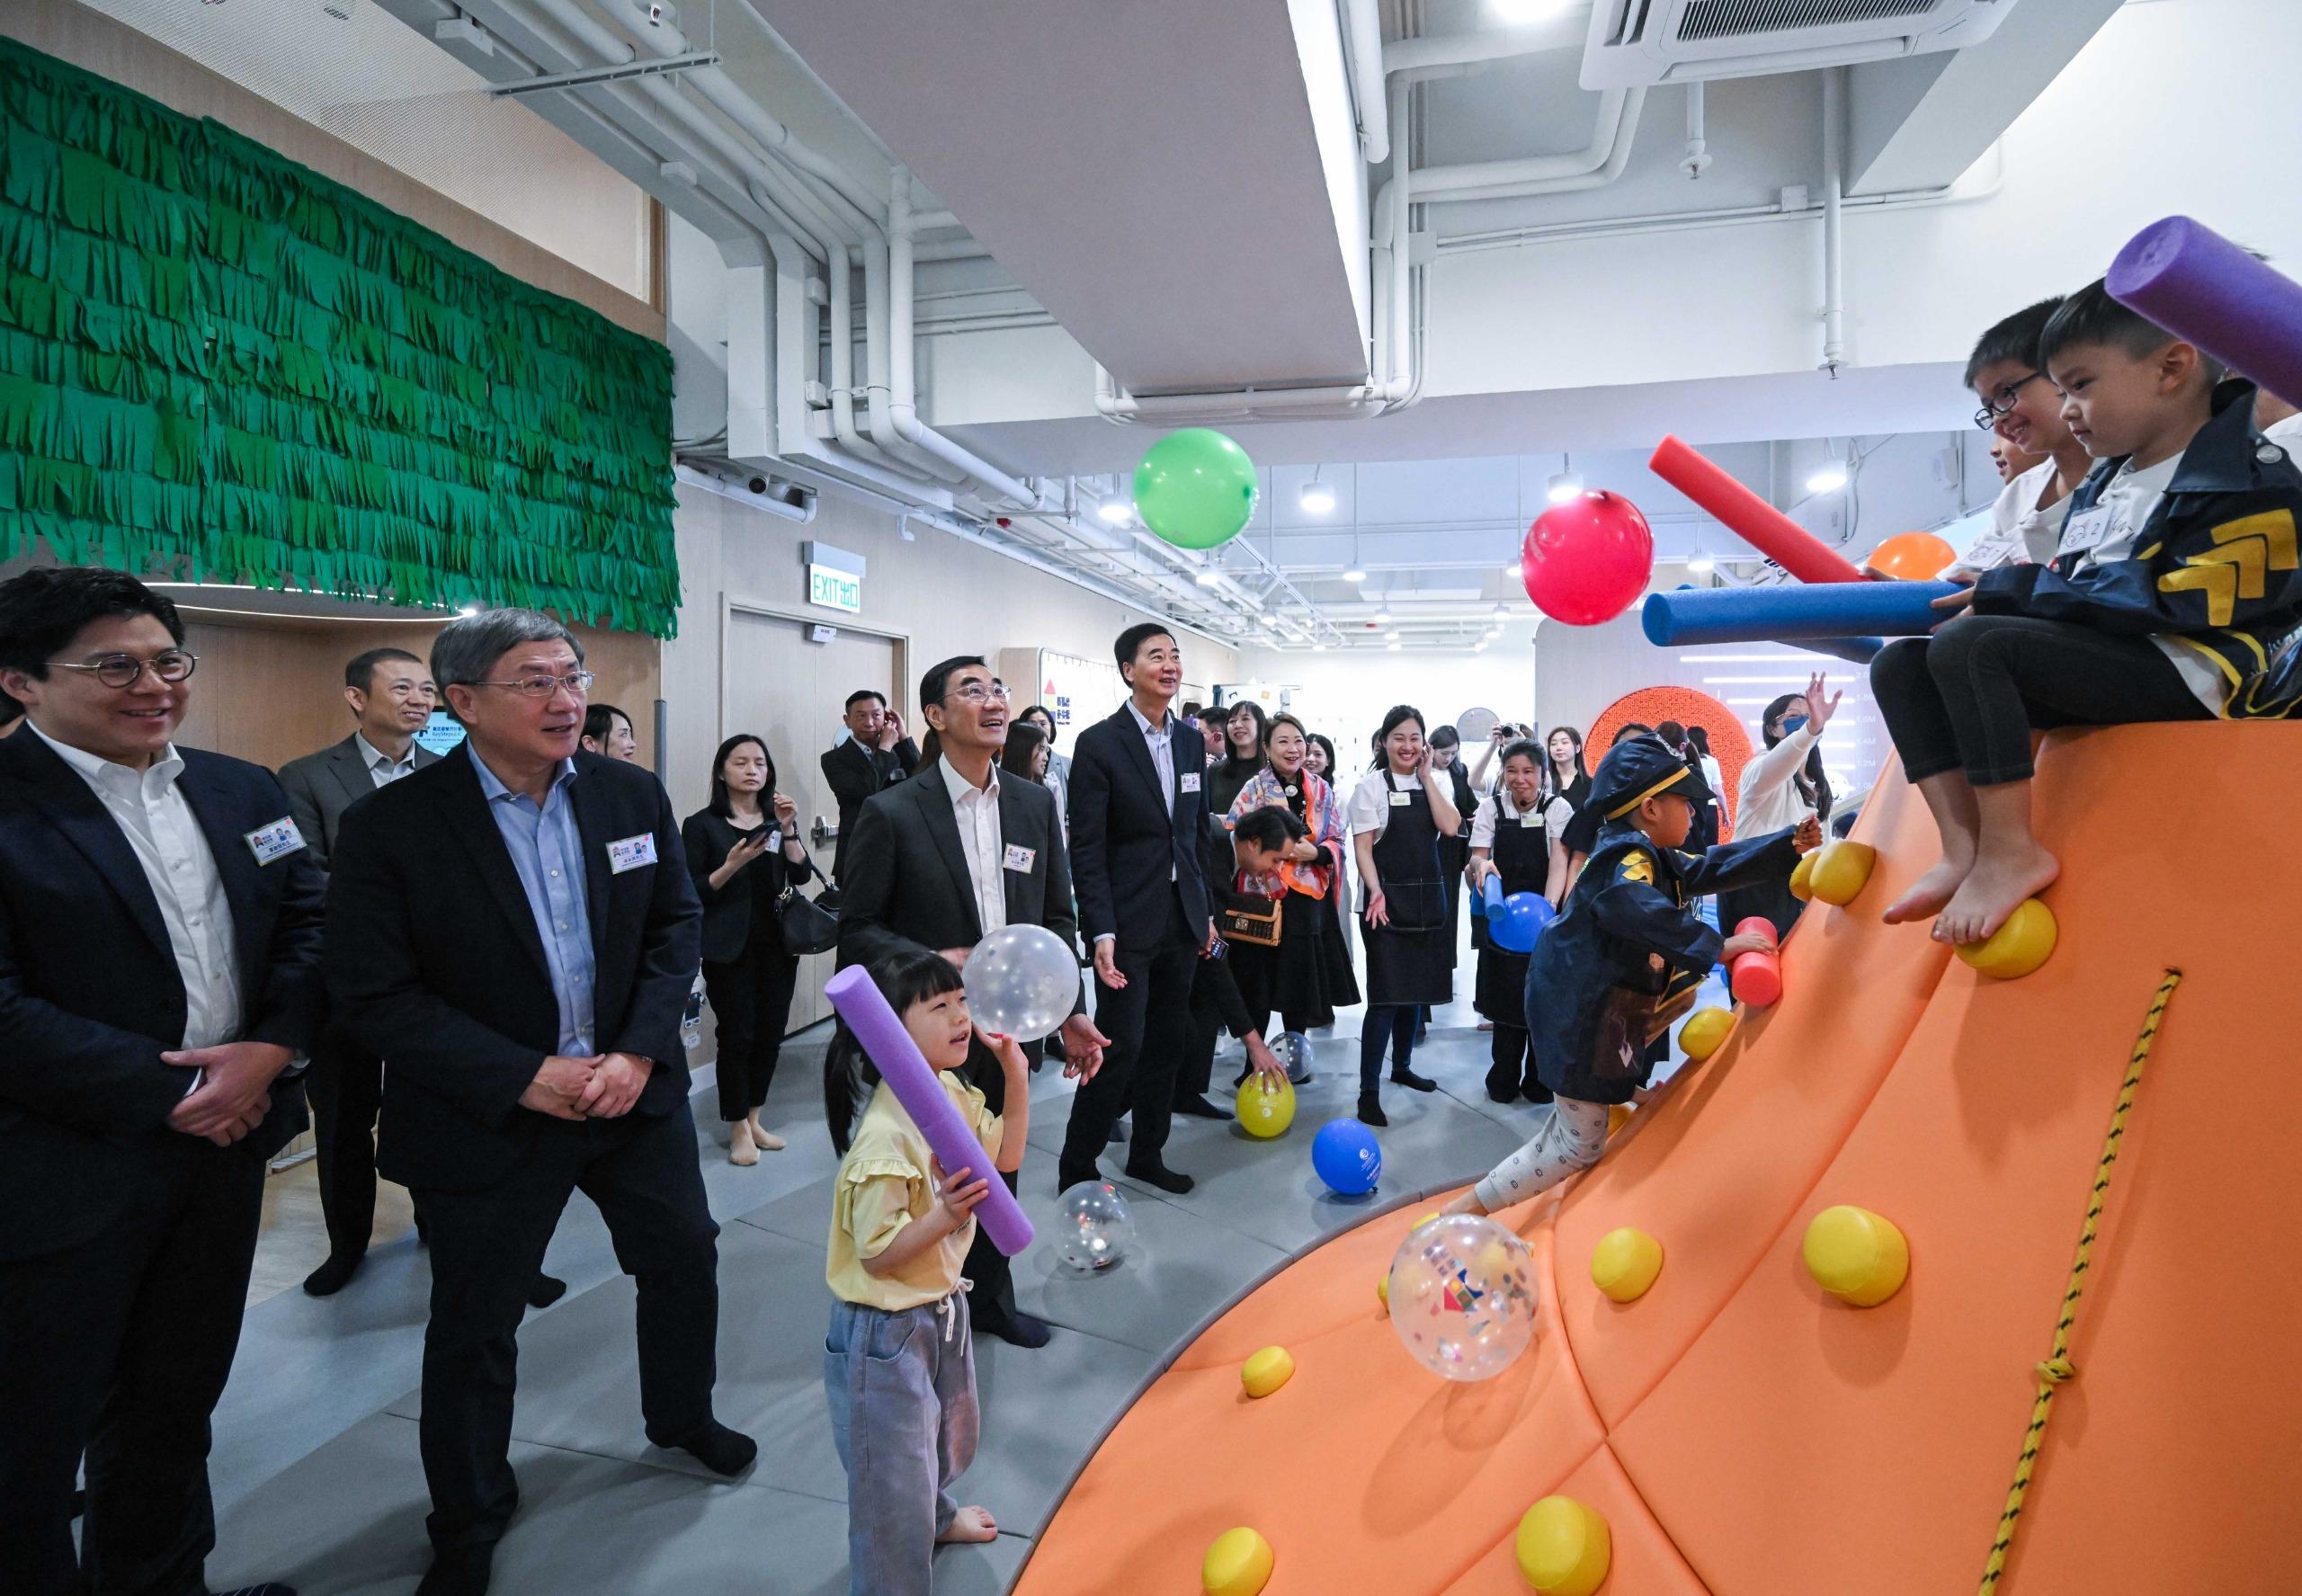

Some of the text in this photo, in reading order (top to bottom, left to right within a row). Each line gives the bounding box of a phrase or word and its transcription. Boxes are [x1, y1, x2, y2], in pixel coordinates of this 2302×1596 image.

[2091, 522, 2101, 535] 2
[814, 574, 858, 608] EXIT 出口
